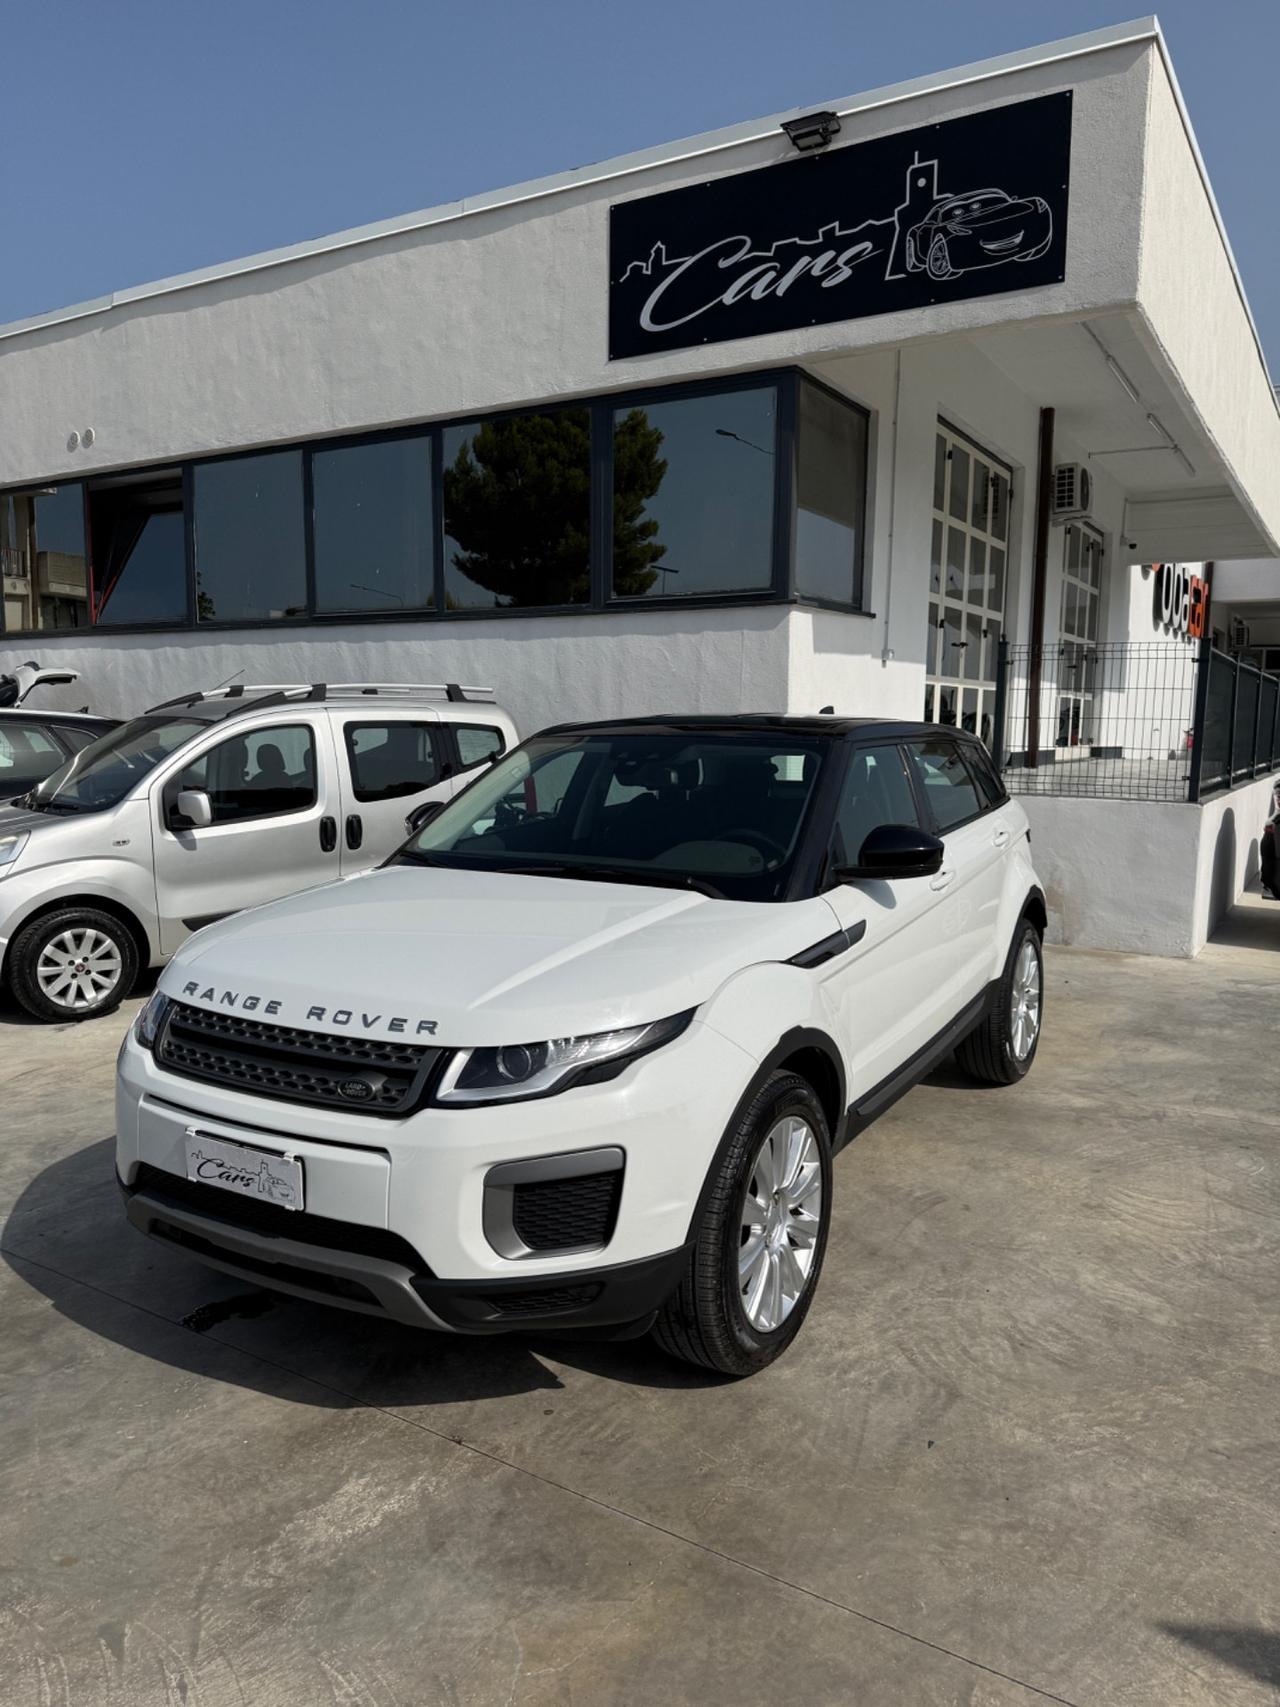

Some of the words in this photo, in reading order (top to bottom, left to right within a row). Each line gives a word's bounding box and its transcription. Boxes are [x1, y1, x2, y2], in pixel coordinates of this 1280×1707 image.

[640, 236, 884, 332] Cars
[183, 981, 282, 1015] RANGE
[306, 1006, 439, 1036] ROVER
[197, 1158, 258, 1187] Cars
